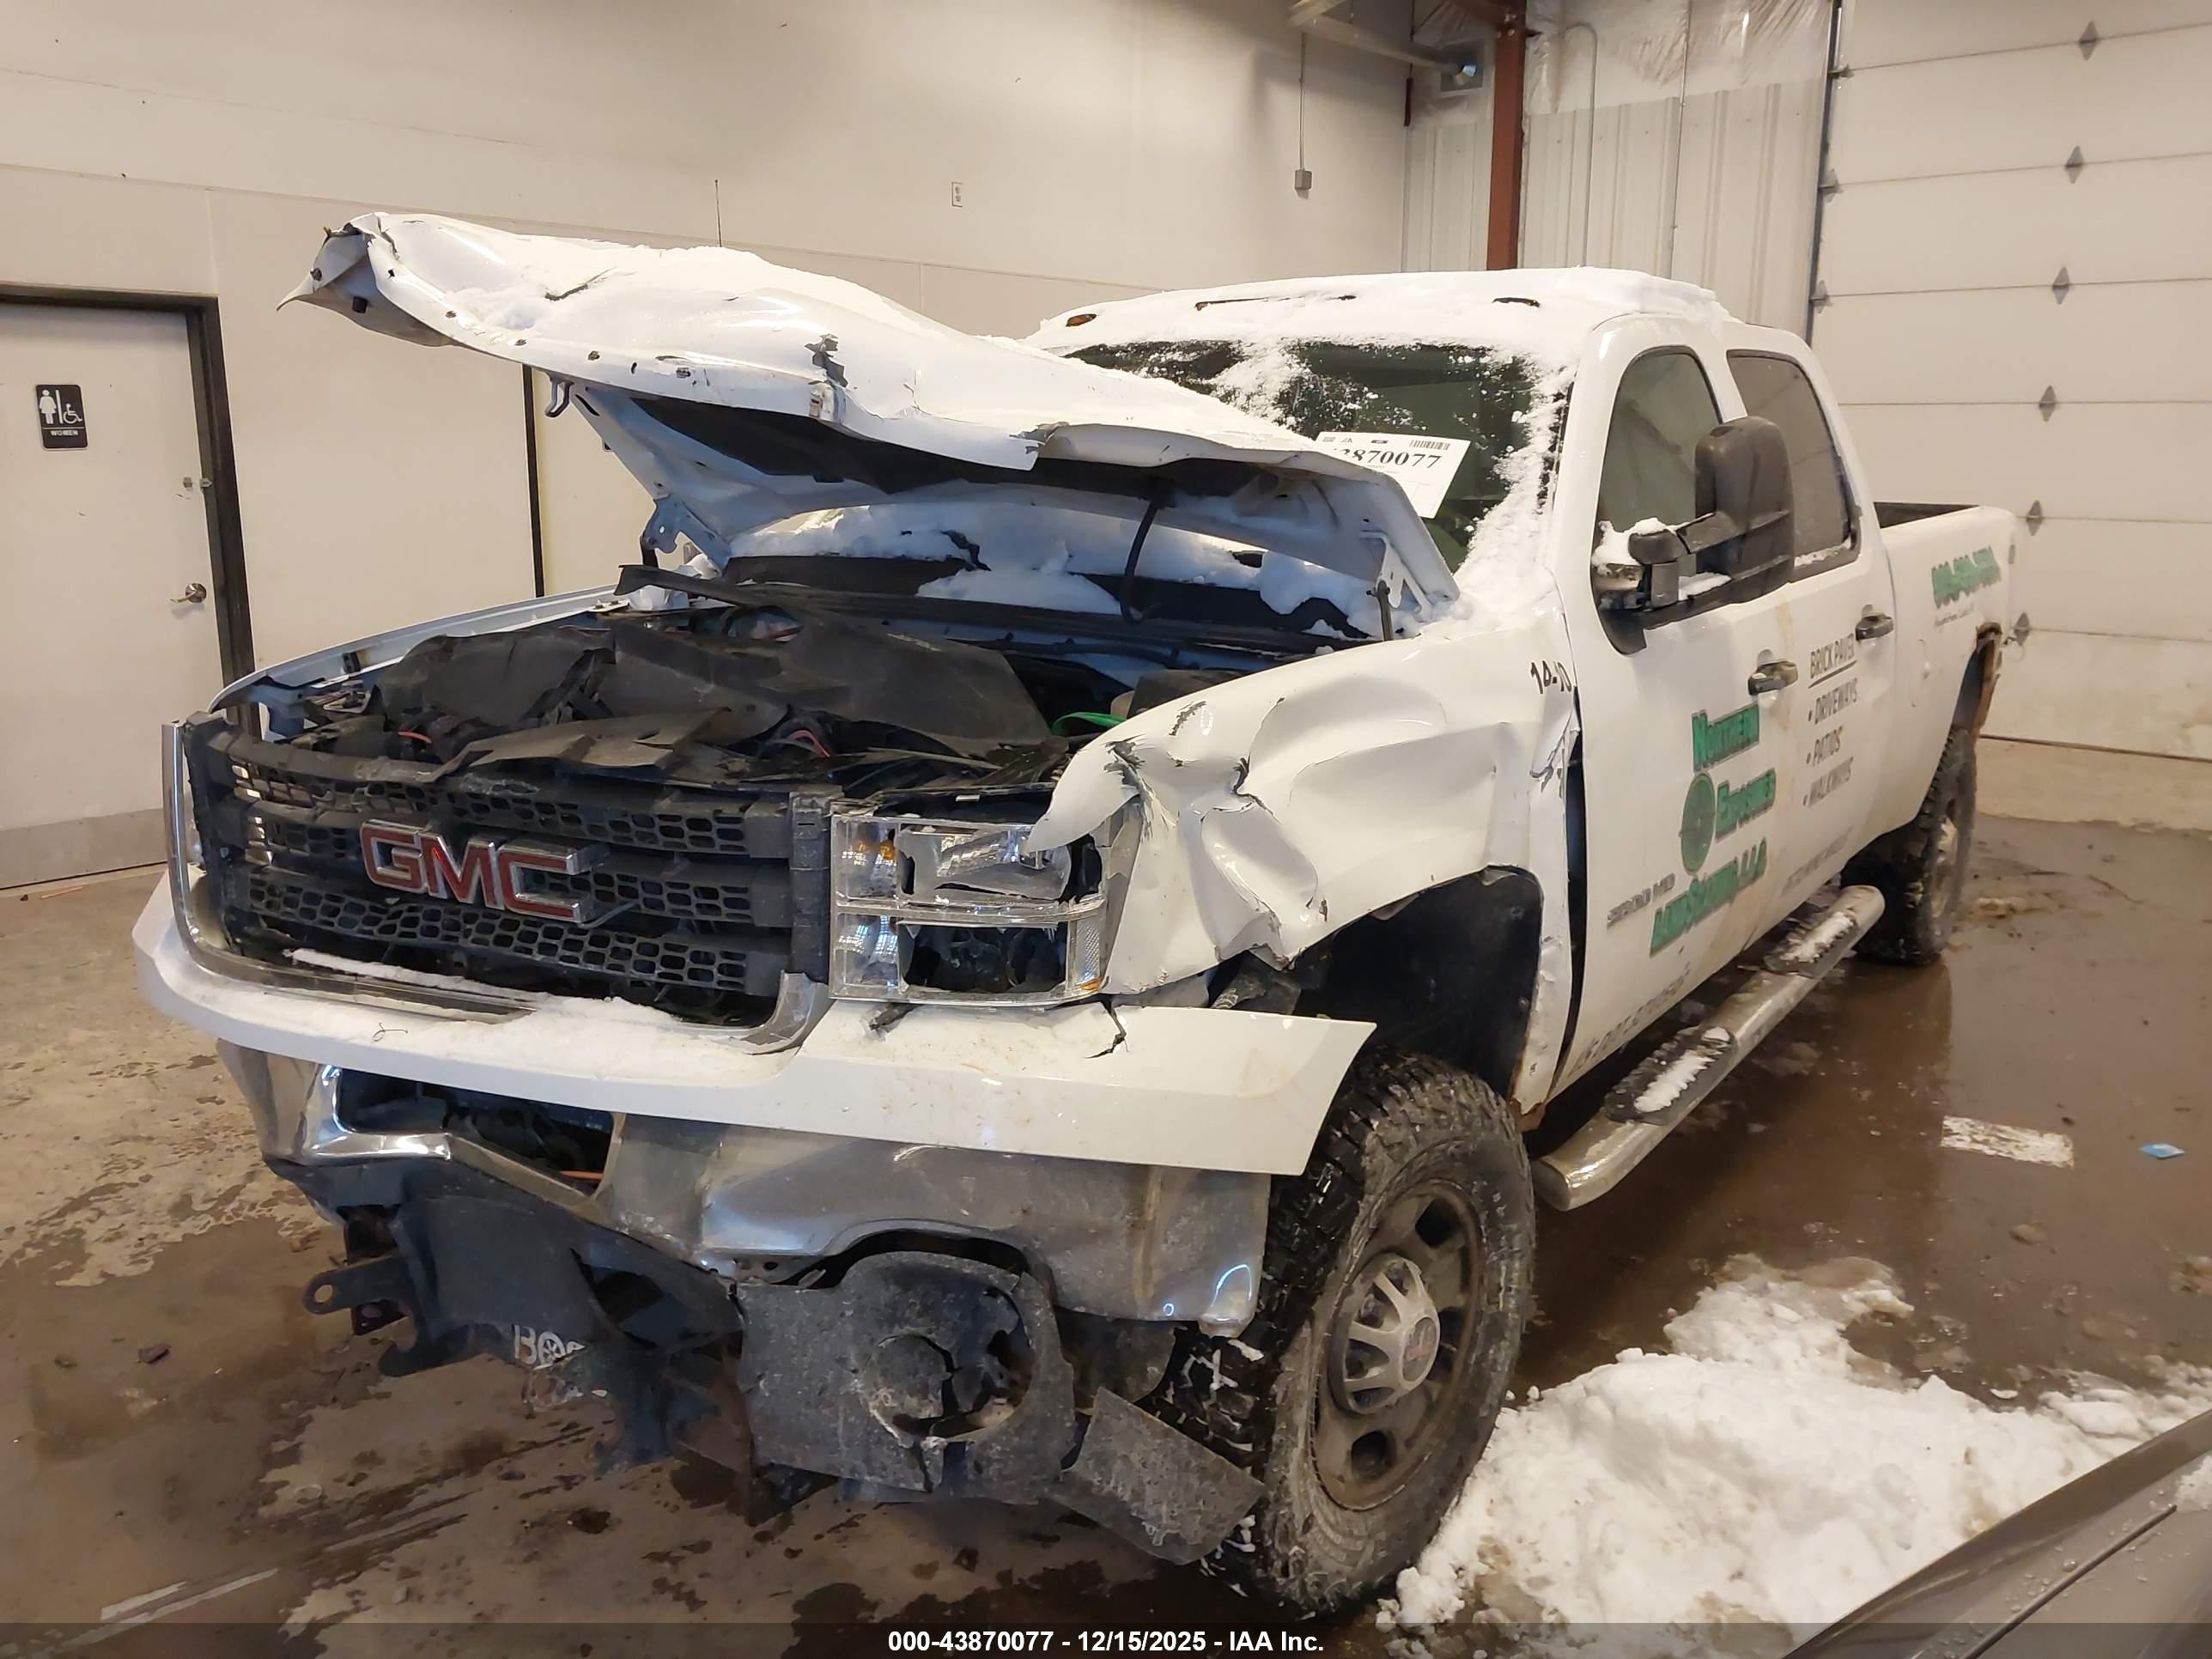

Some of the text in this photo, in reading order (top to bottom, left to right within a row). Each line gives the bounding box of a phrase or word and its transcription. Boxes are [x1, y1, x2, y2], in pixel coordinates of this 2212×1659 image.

[1333, 447, 1443, 469] 870077
[1810, 645, 1833, 679] BRICK
[1813, 726, 1843, 766] PATIOS
[359, 817, 583, 924] GMC
